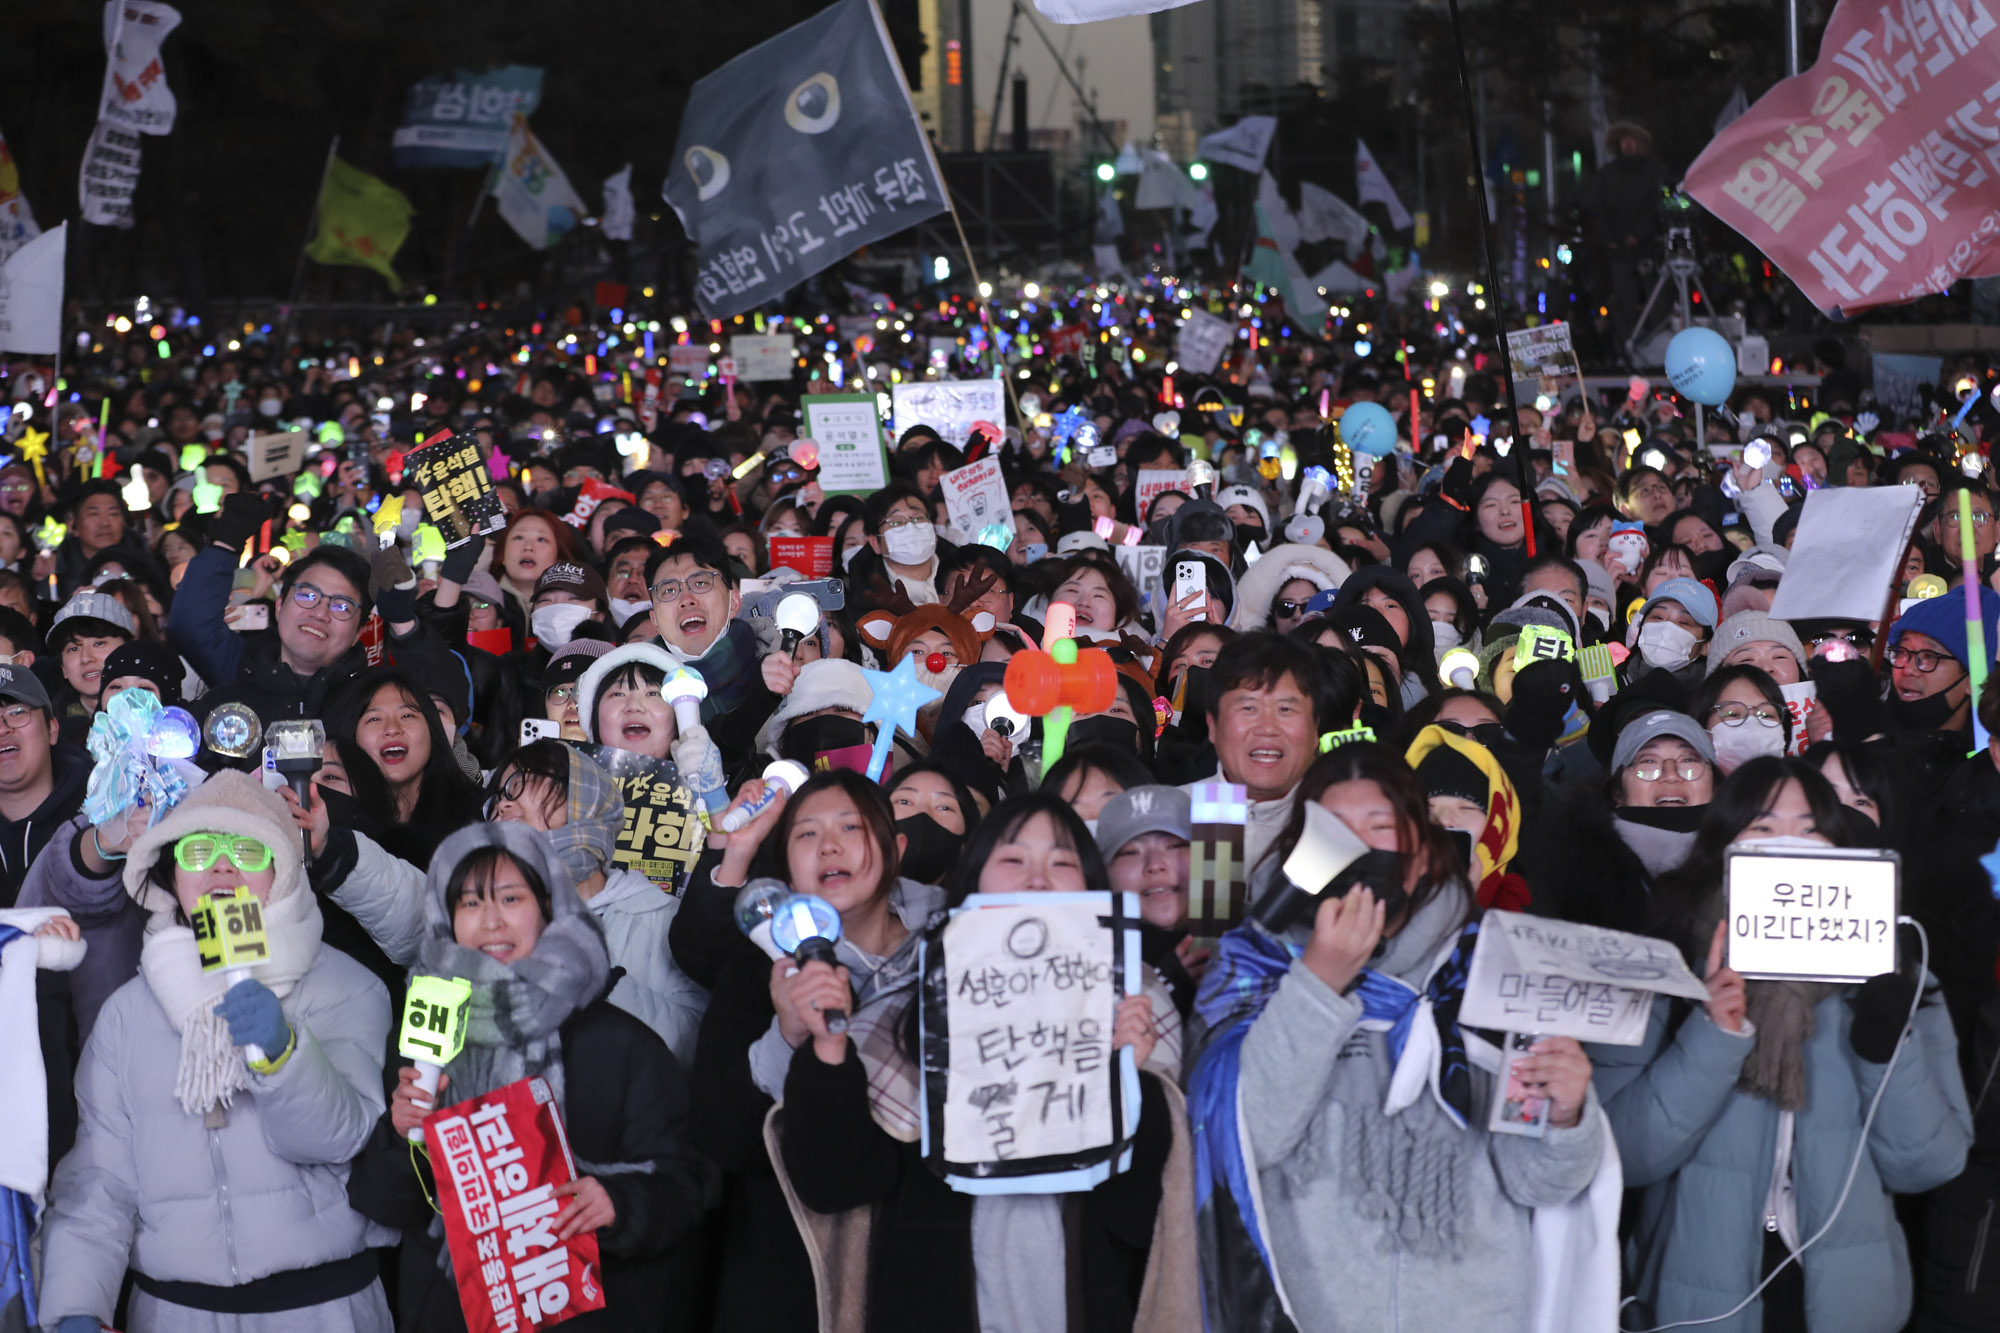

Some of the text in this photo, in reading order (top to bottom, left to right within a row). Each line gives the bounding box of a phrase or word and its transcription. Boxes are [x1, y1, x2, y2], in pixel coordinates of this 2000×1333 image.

[432, 445, 481, 482] 윤석열
[422, 465, 491, 522] 탄핵!
[1772, 883, 1852, 910] 우리가
[1736, 914, 1888, 943] 이긴다했지?
[958, 965, 1040, 1009] 성훈아
[1498, 973, 1649, 1027] 만들어줄게
[408, 998, 450, 1058] 핵
[976, 1018, 1104, 1074] 탄핵을
[442, 1122, 519, 1333] 내란동조 국민의힘
[469, 1102, 571, 1326] 해체하라
